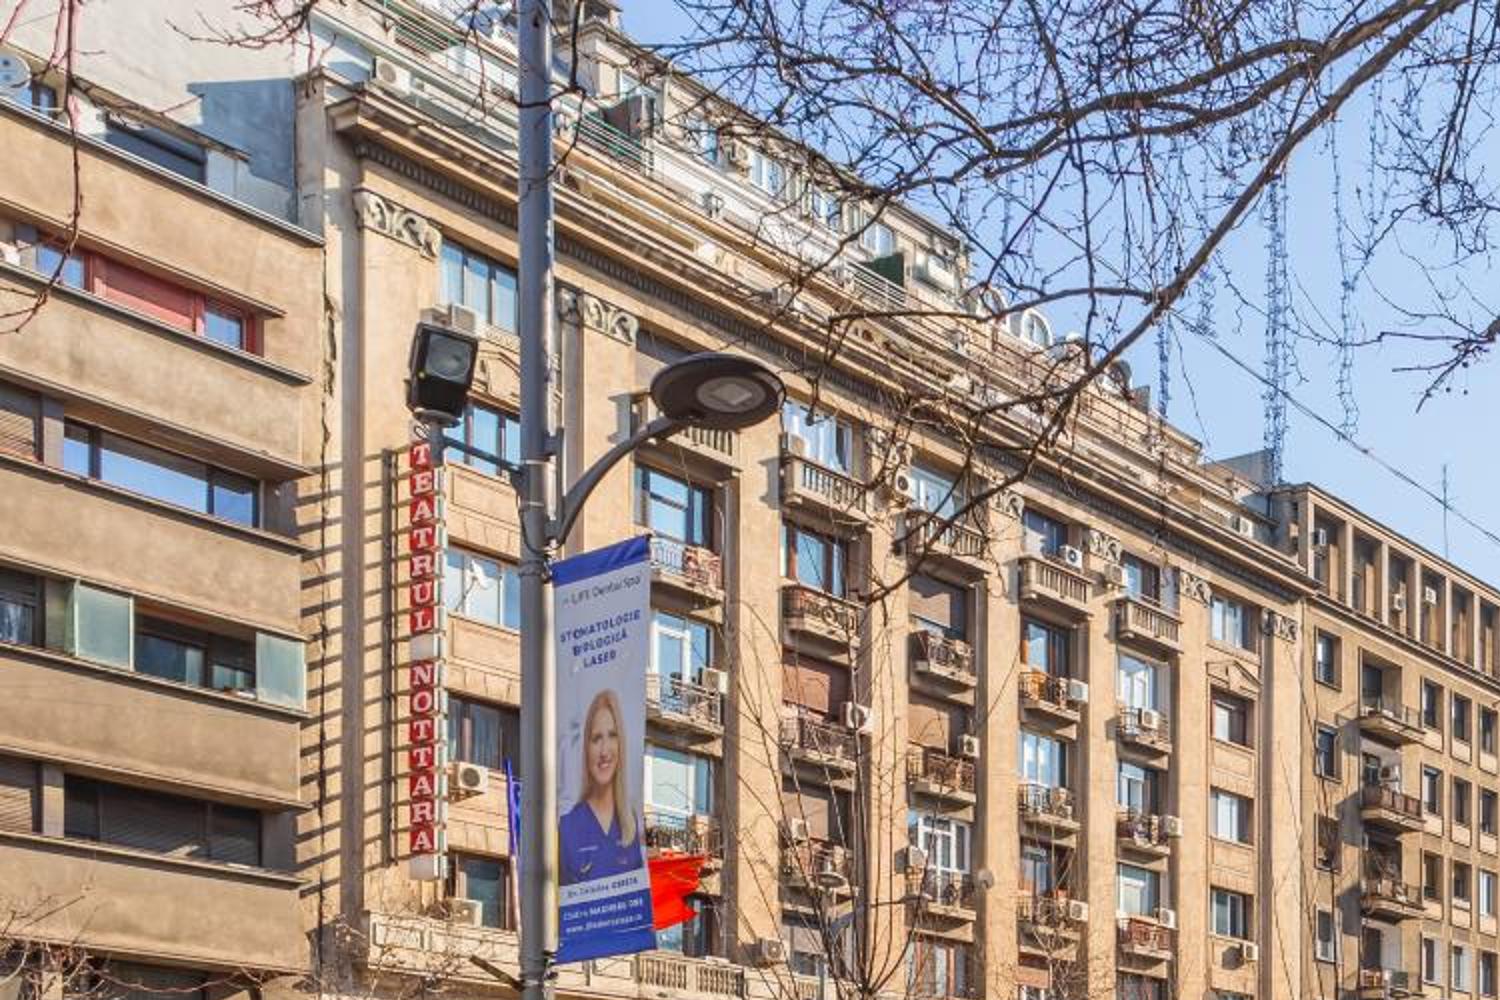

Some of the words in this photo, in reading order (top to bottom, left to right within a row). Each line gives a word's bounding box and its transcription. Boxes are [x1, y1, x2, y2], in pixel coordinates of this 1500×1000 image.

[411, 444, 433, 632] TEATRUL
[560, 610, 641, 643] STOMATOLOGIE
[411, 665, 433, 851] NOTTARA
